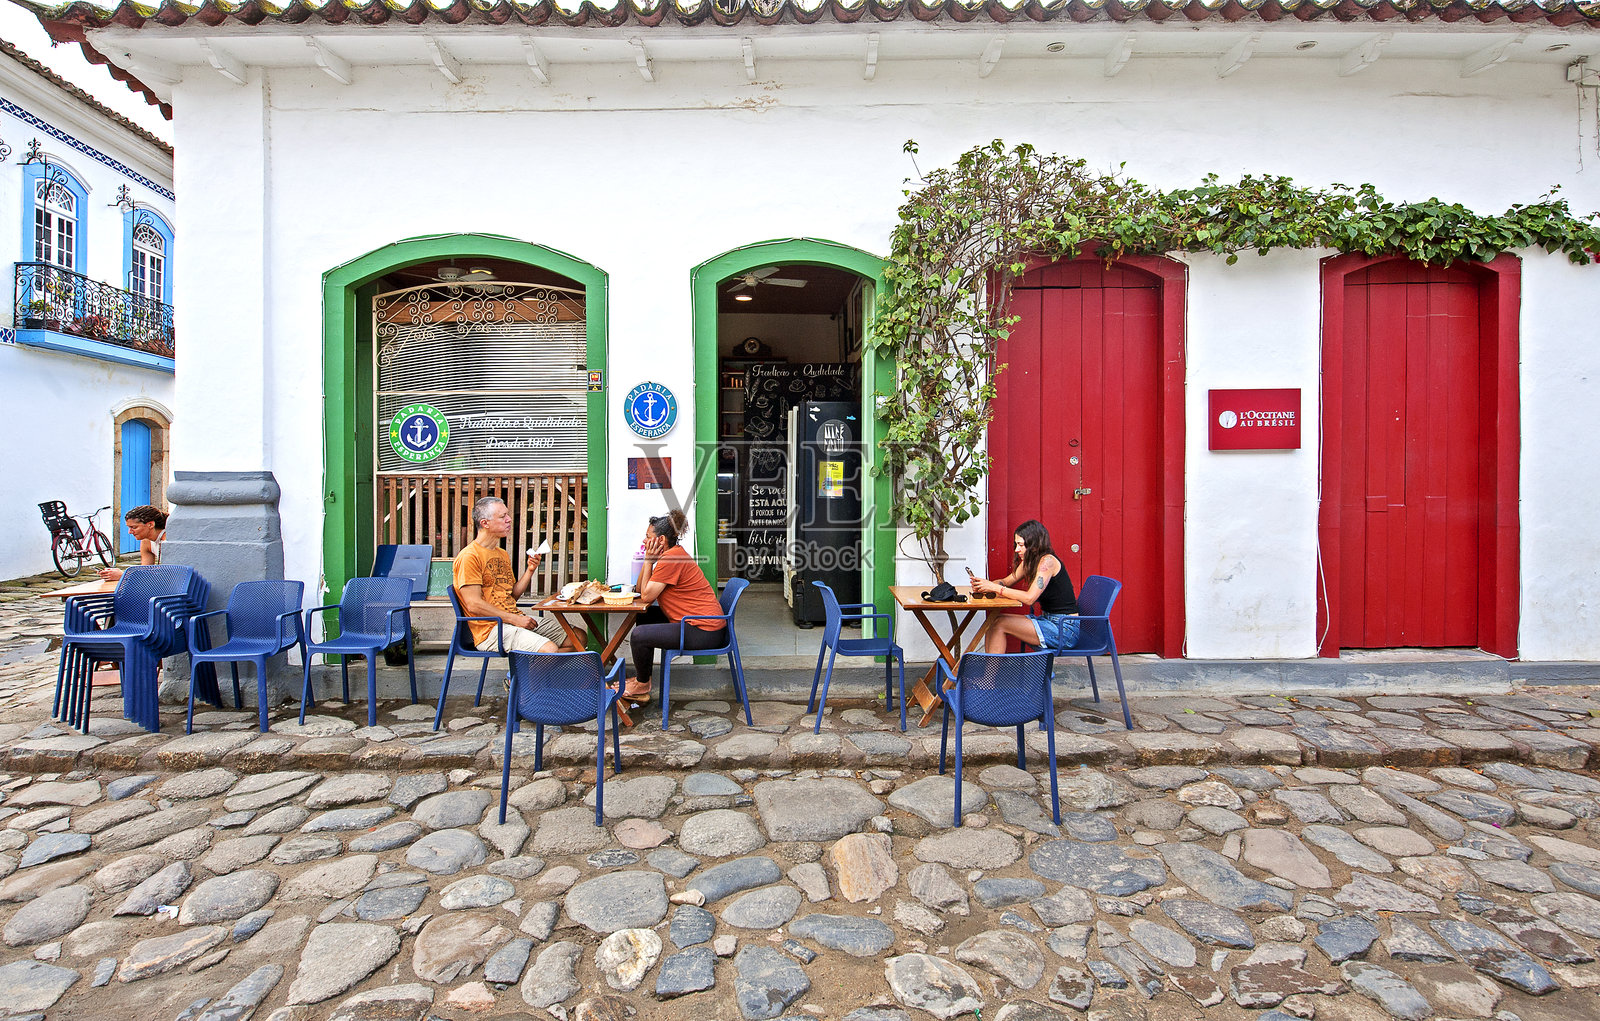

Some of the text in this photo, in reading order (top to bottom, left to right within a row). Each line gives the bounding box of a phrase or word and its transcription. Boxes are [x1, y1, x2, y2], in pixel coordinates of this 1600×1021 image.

[803, 363, 845, 378] Qualidade
[628, 383, 673, 401] PADARIA
[394, 405, 444, 425] PADARIA
[1240, 410, 1295, 419] L'OCCITANE
[524, 416, 582, 430] Qualidade
[1257, 418, 1296, 427] BRÉSIL
[486, 436, 526, 448] Desde
[393, 441, 445, 460] ESPERANÇA
[751, 484, 766, 496] Se
[771, 498, 787, 507] AQU
[755, 509, 774, 517] PORQUE
